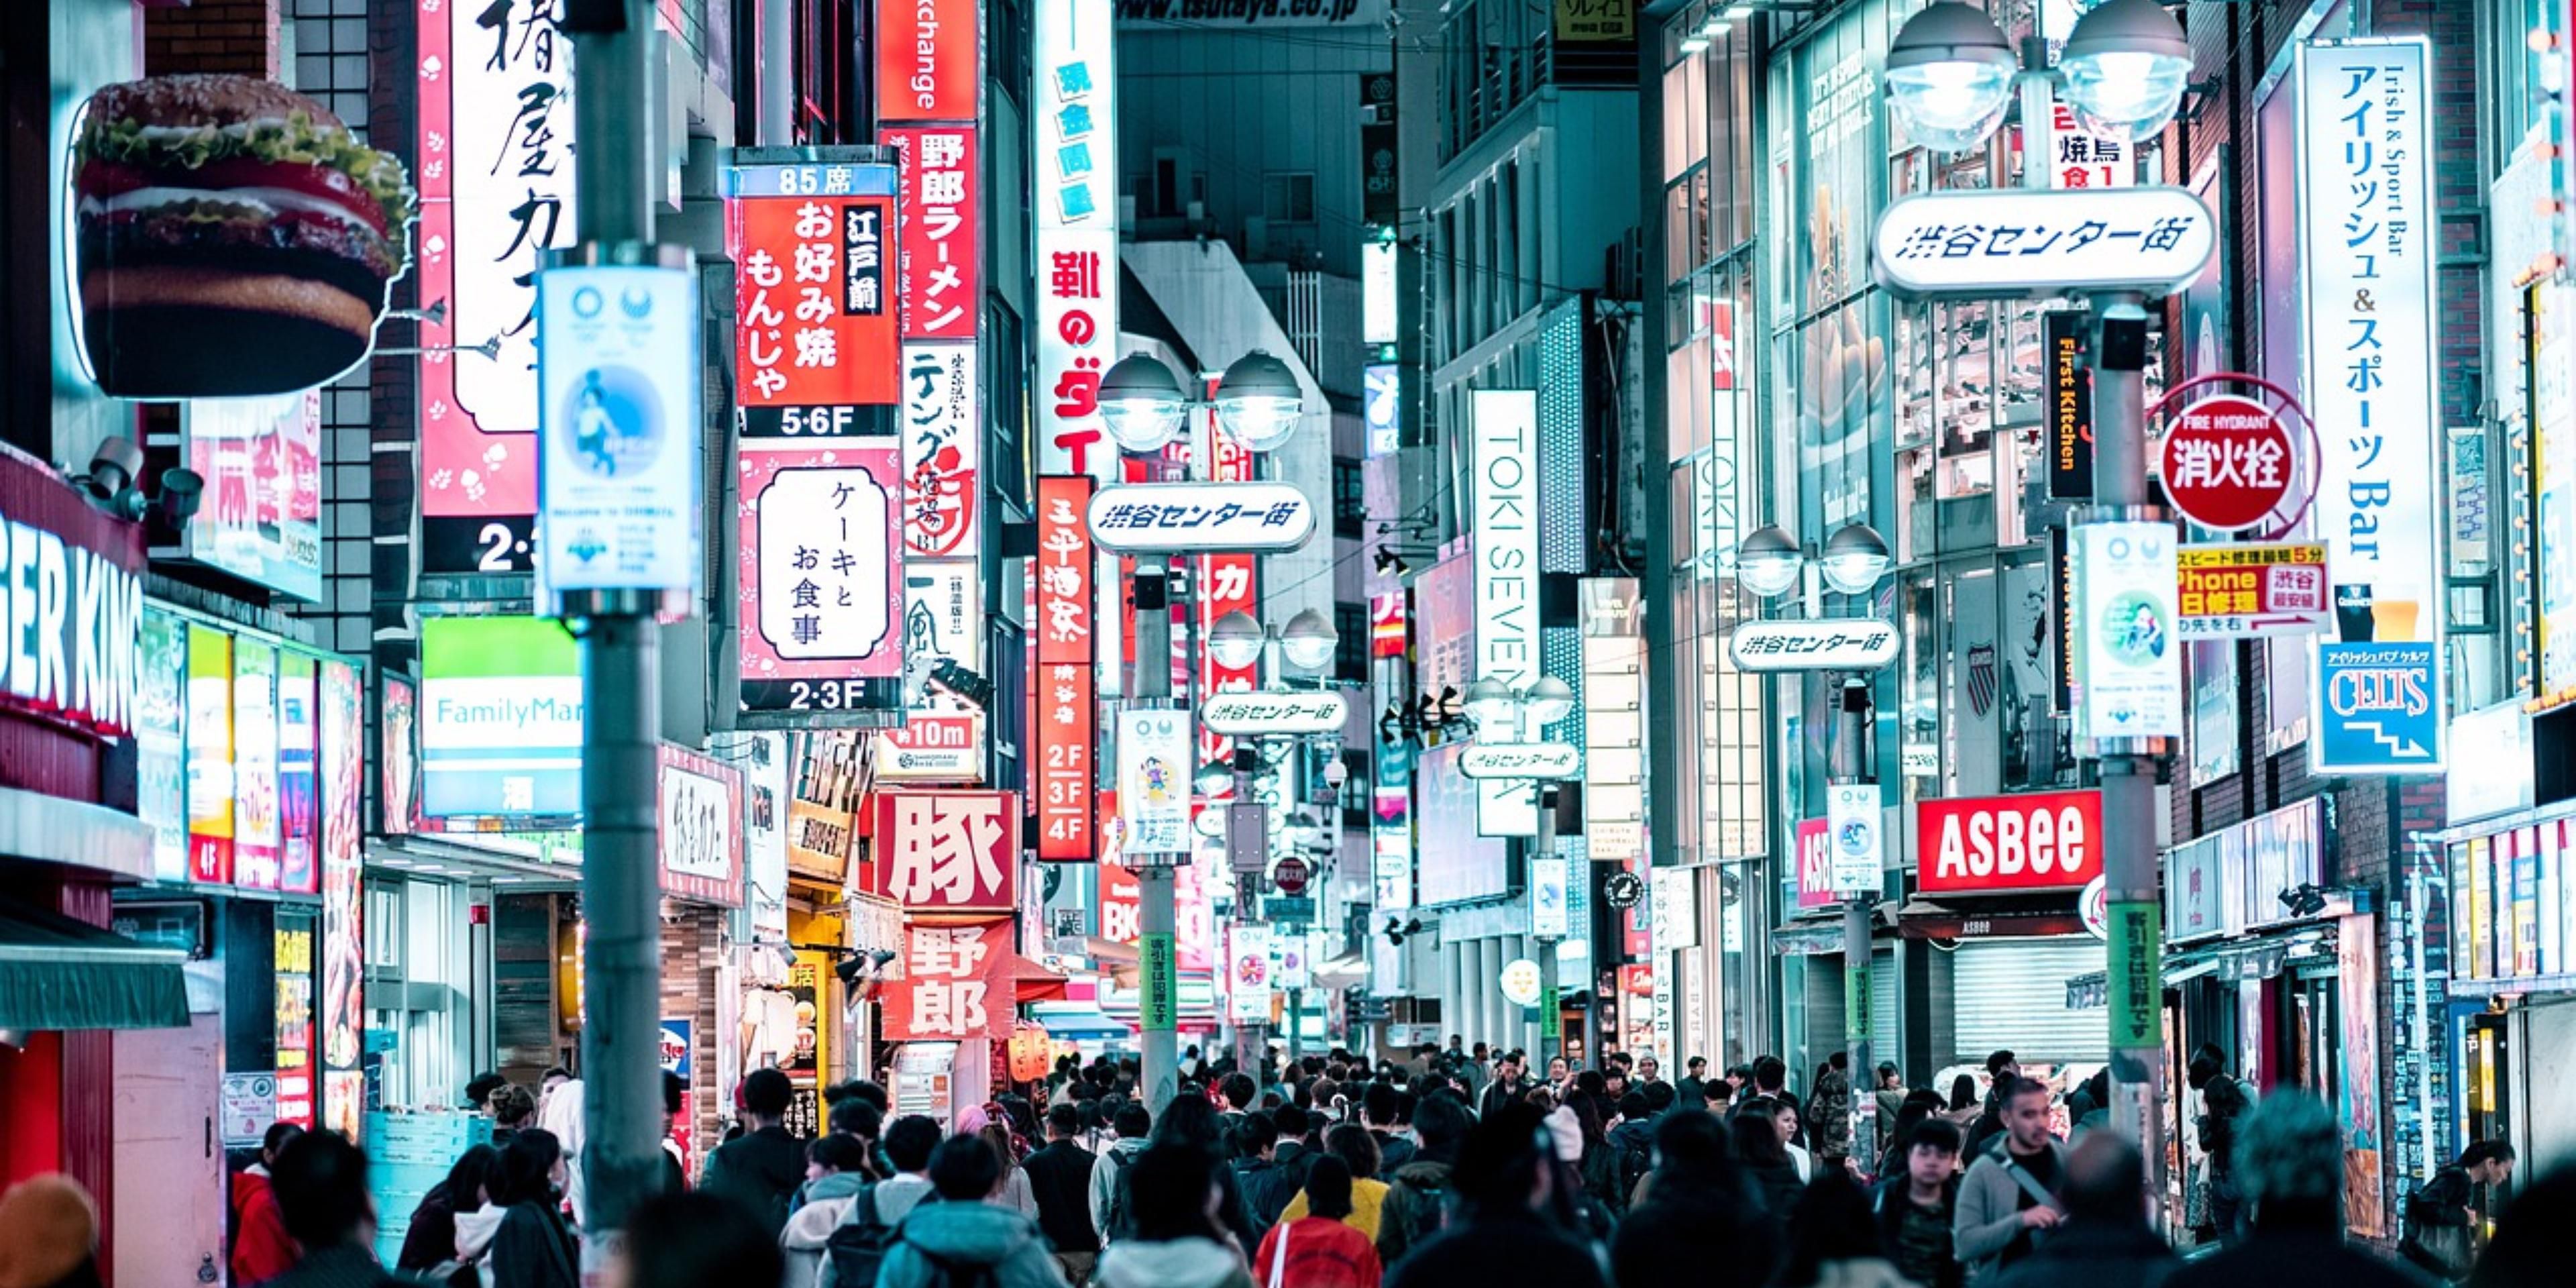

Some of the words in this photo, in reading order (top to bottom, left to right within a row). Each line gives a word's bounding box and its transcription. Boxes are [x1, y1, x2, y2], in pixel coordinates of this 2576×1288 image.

[2385, 66, 2405, 125] Irish
[2386, 129, 2402, 141] &
[2381, 150, 2406, 213] Sport
[847, 210, 877, 311] 江戸前
[921, 134, 965, 333] 野郎ラーメン
[1896, 217, 2194, 260] 渋谷センター街
[2388, 220, 2407, 256] Bar
[794, 203, 837, 367] お好み焼
[746, 249, 788, 399] もんじゃ
[2060, 338, 2076, 387] First
[2060, 390, 2077, 470] Kitchen
[2183, 415, 2210, 430] FIRE
[2213, 415, 2271, 430] HYDRANT
[1489, 427, 1523, 530] TOKI
[2173, 437, 2284, 489] 消火栓
[1098, 502, 1299, 529] 渋谷センター街
[2349, 480, 2391, 560] Bar
[831, 482, 856, 608] ケーキと
[791, 545, 822, 645] お食事
[2182, 590, 2258, 615] 日修理
[2274, 570, 2314, 590] 渋谷
[76, 545, 144, 739] KING
[1741, 633, 1888, 653] 渋谷センター街
[437, 698, 584, 728] FamilyMar
[1211, 704, 1337, 720] 渋谷センター街
[2328, 667, 2428, 717] CELTS
[1048, 745, 1083, 767] 2F
[1048, 782, 1083, 804] 3F
[889, 796, 1004, 904] 豚
[1048, 818, 1083, 840] 4F
[1936, 806, 2084, 879] ASBee
[1802, 833, 1829, 894] ASB
[909, 926, 987, 1035] 野郎
